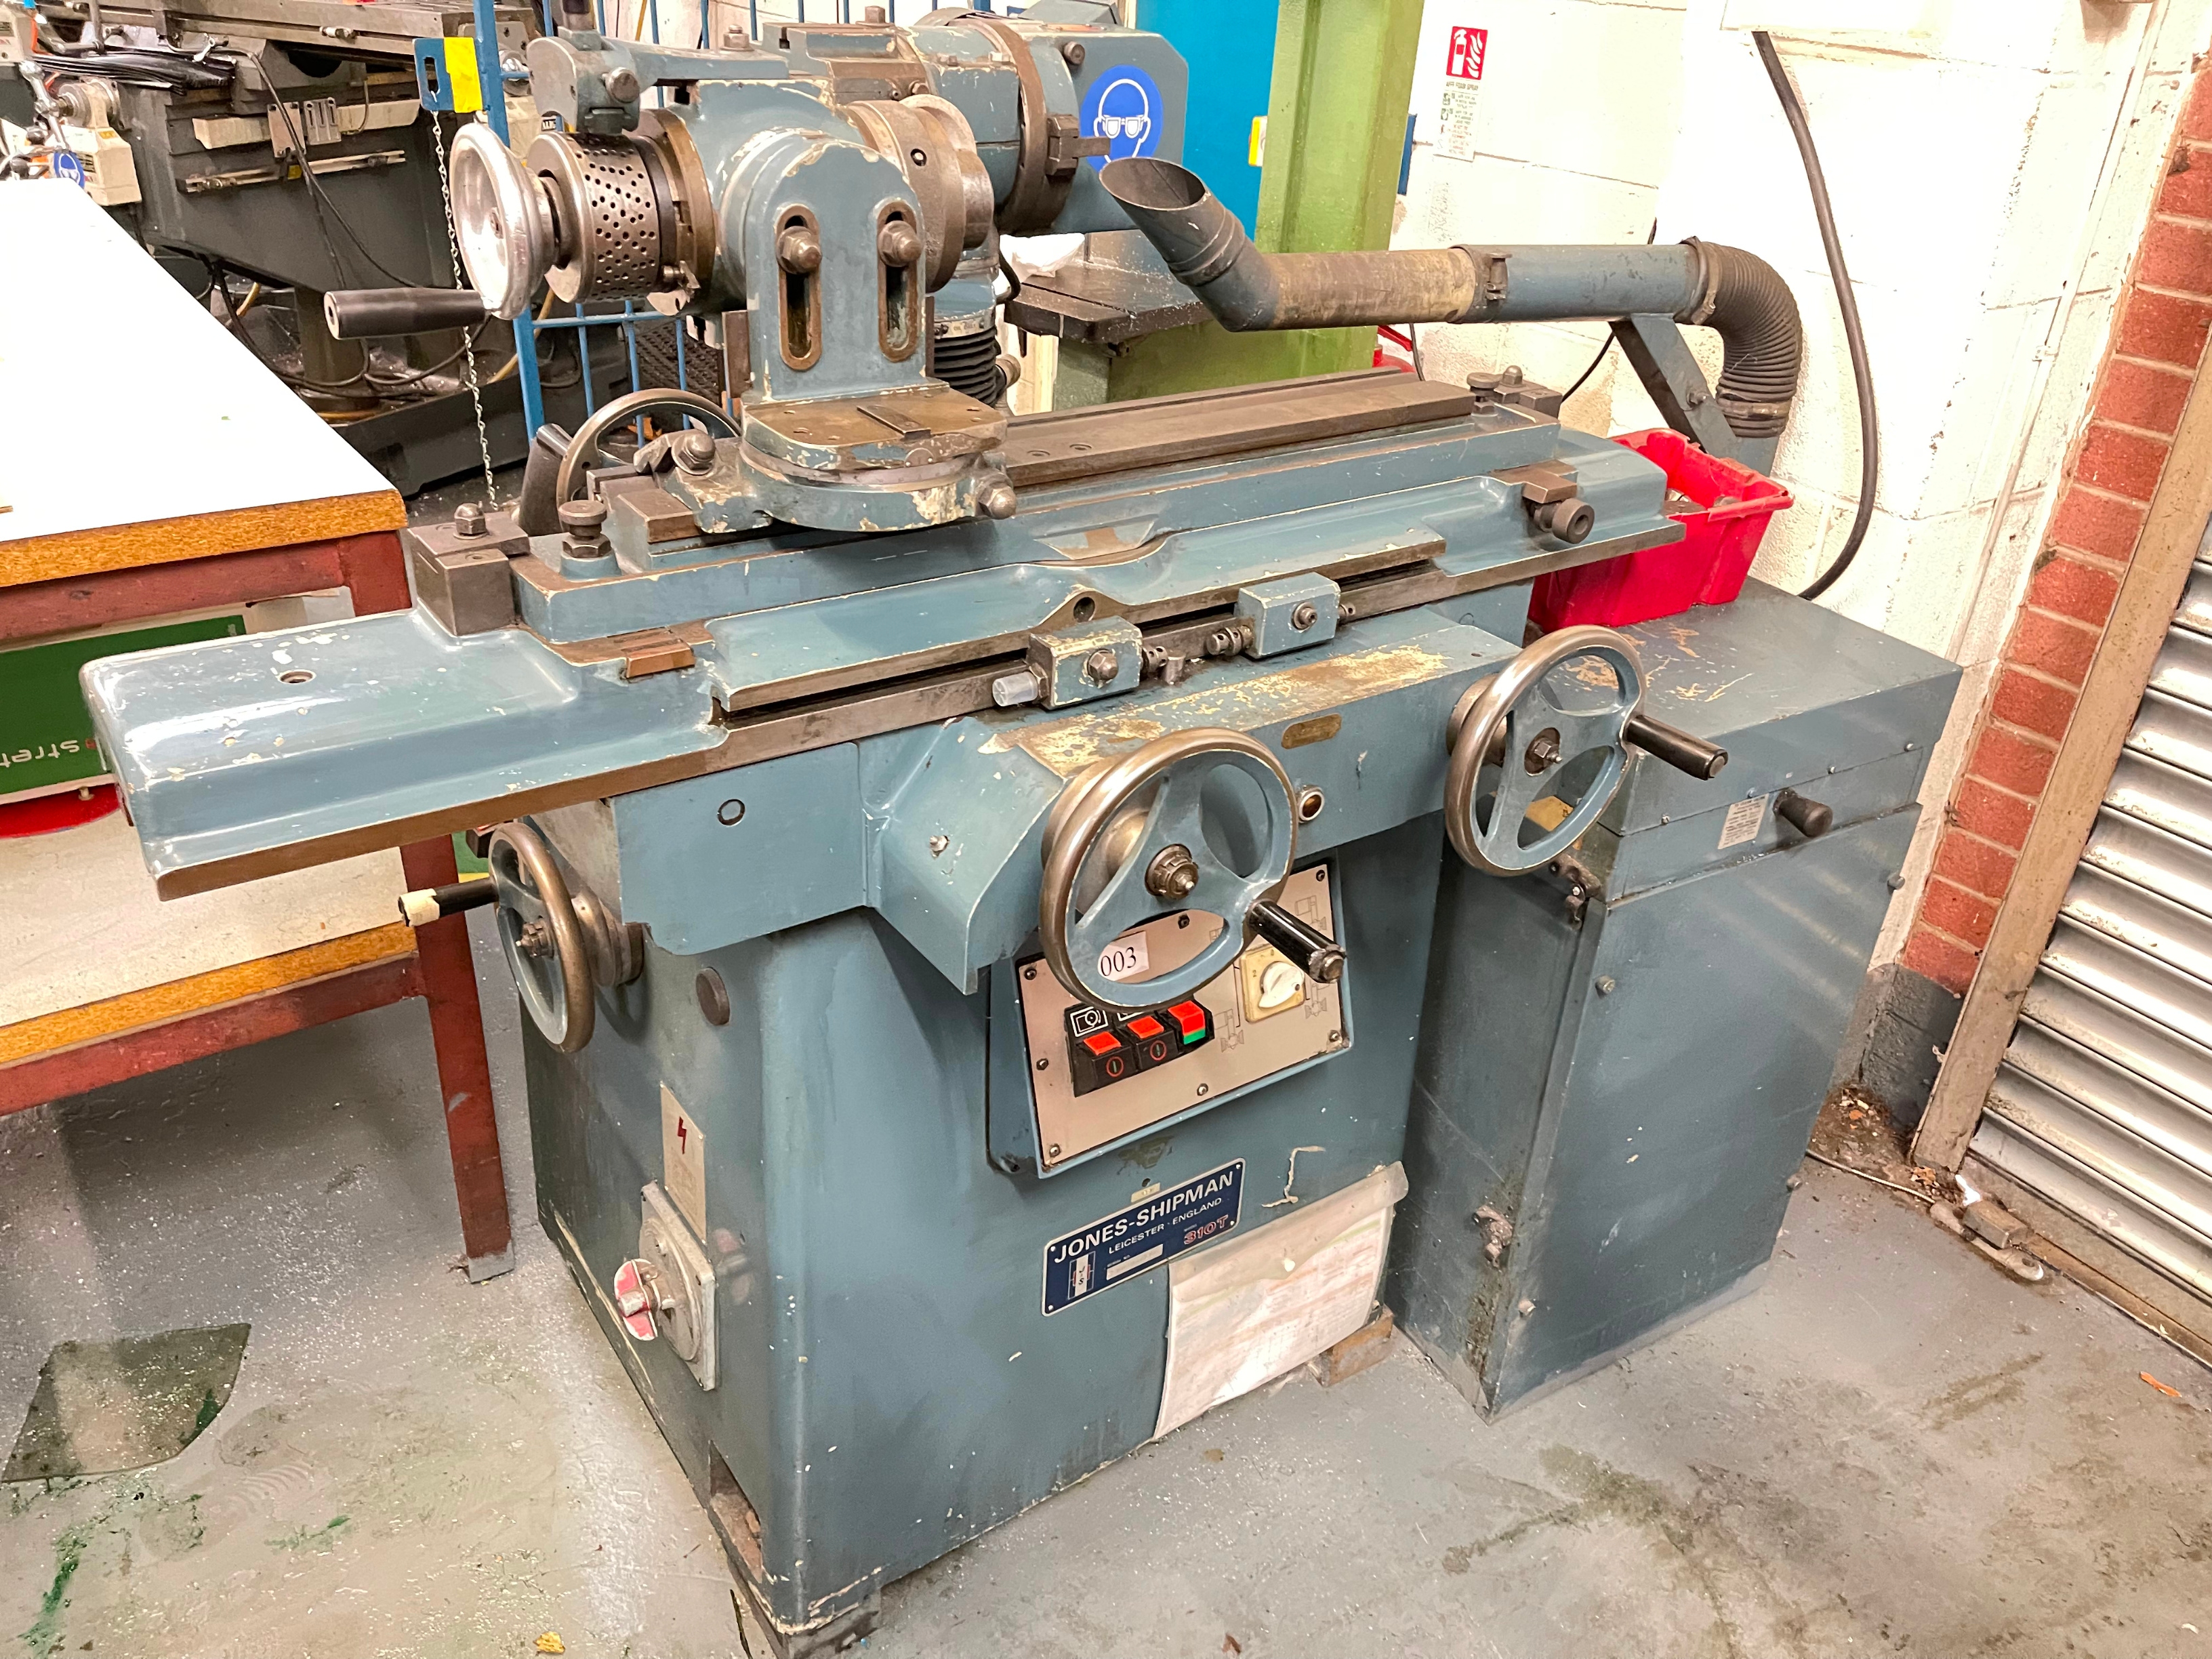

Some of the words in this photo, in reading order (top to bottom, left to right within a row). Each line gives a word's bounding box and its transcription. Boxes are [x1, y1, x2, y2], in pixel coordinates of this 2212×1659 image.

[1101, 947, 1136, 976] 003
[1054, 1171, 1233, 1263] JONES-SHIPMAN
[1109, 1223, 1164, 1254] LEICESTER
[1172, 1197, 1222, 1225] ENGLAND
[1183, 1214, 1229, 1246] 310T
